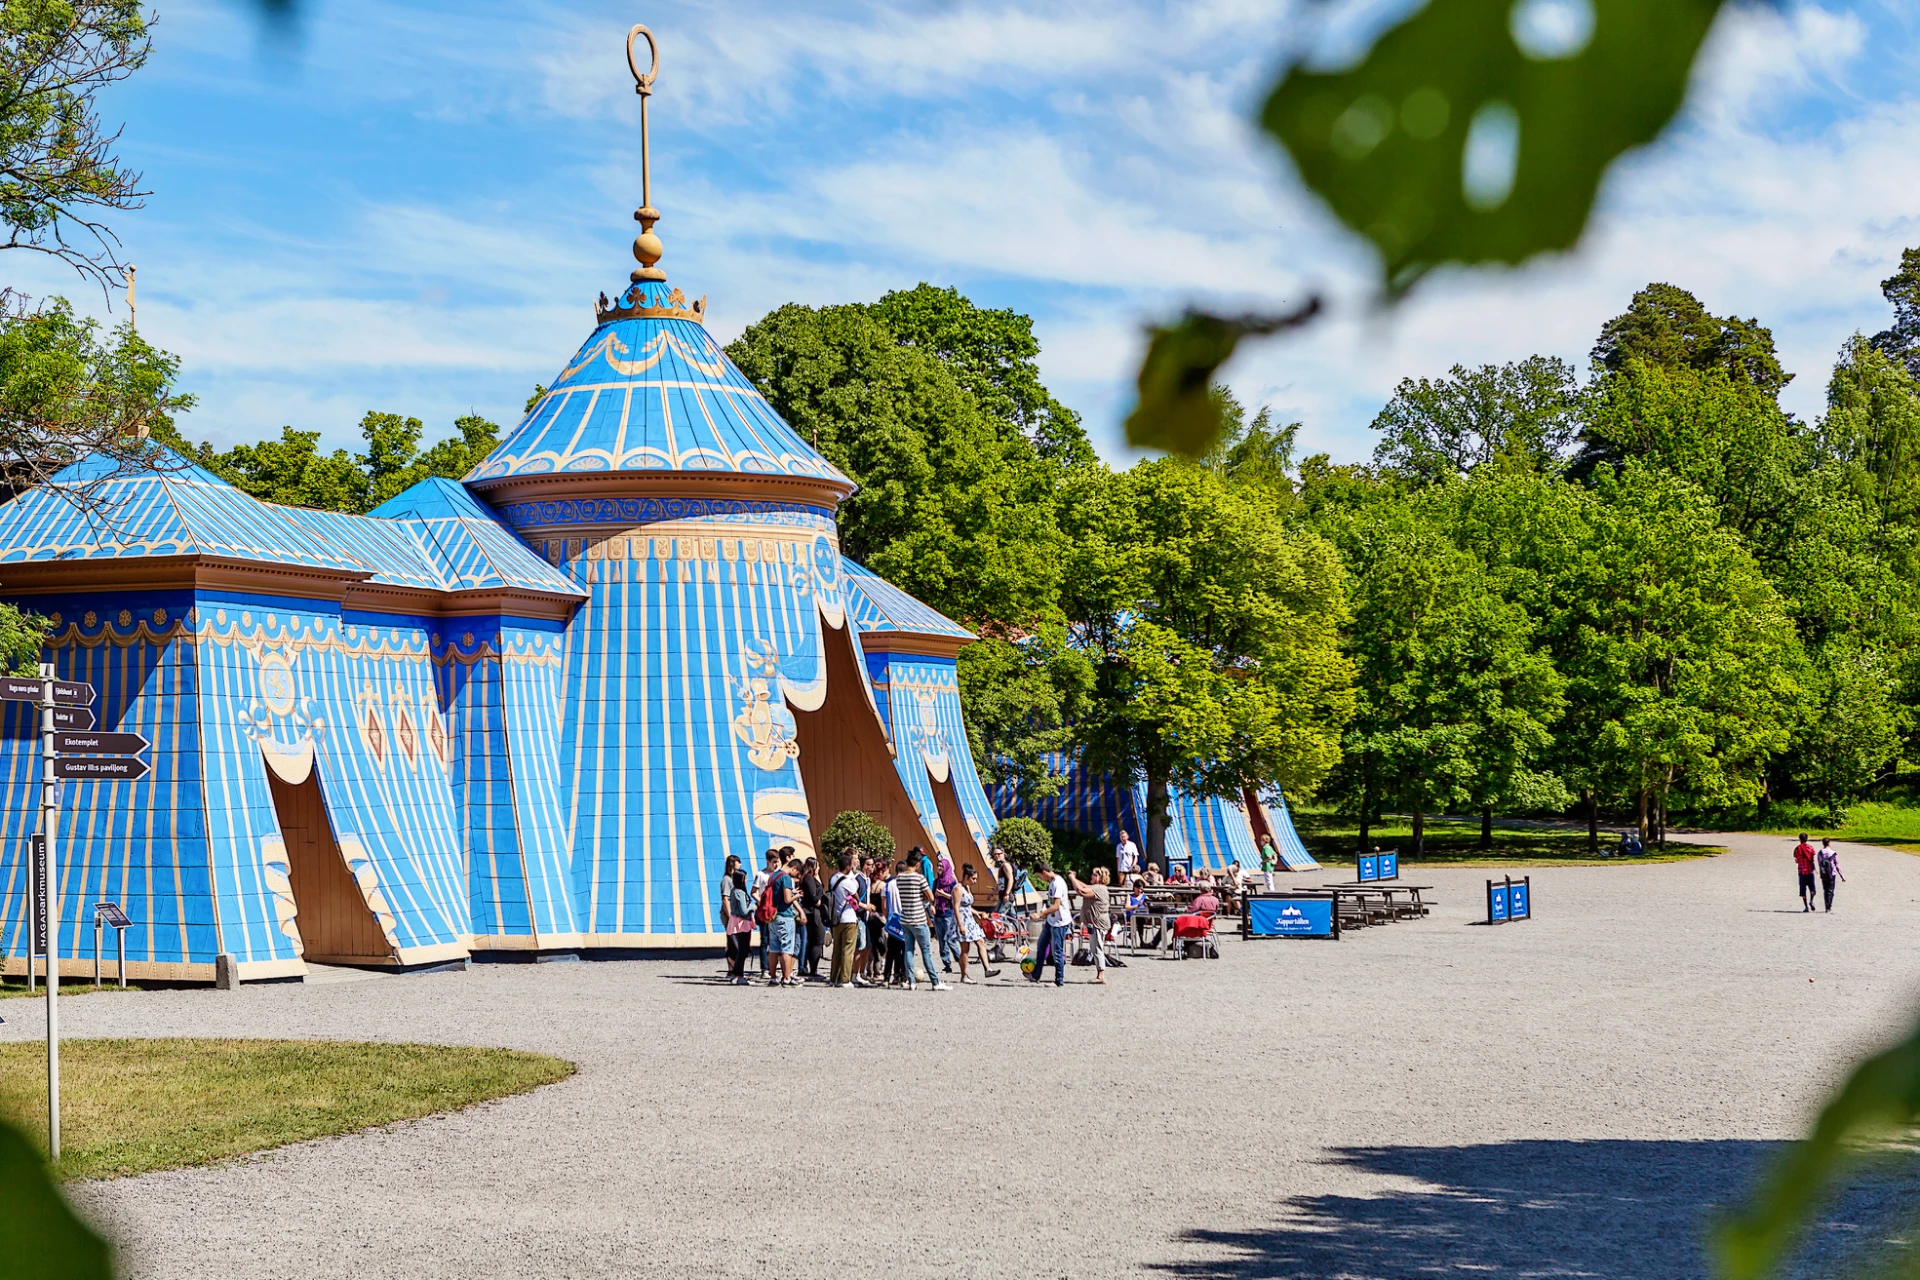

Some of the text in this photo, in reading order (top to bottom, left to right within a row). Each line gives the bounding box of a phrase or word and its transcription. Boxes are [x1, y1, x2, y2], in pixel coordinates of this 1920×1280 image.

[65, 738, 99, 747] Ekotemplet
[65, 763, 87, 771] Gustav
[100, 764, 128, 773] paviljong
[38, 842, 47, 947] HAGAparkmuseum
